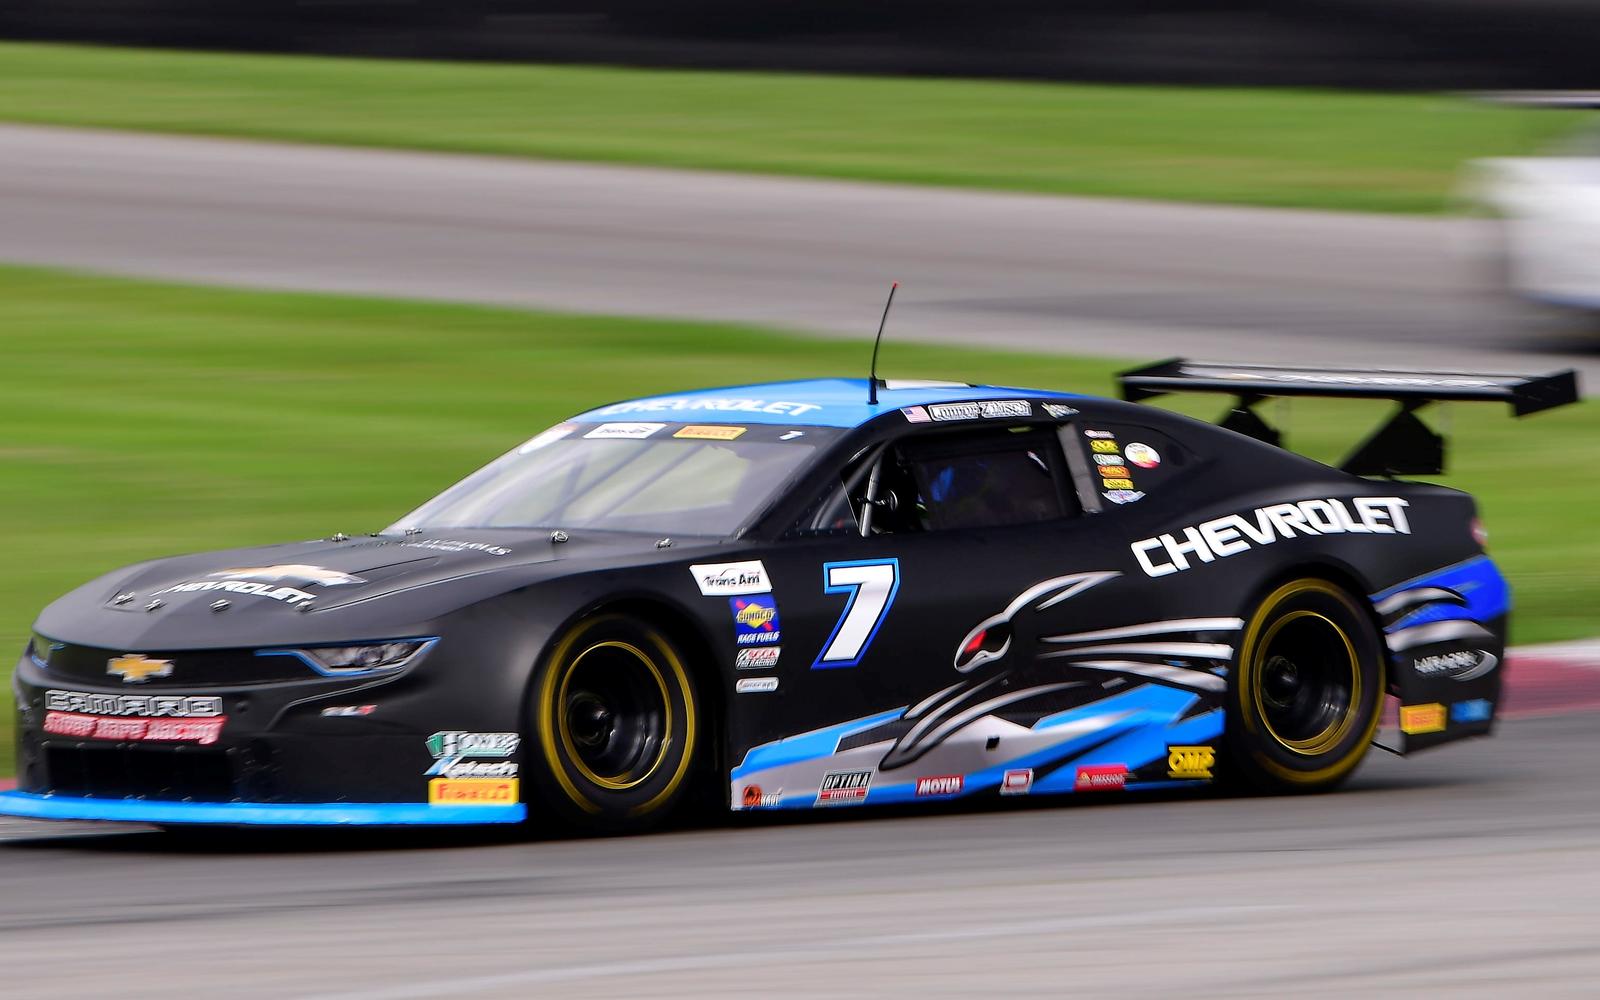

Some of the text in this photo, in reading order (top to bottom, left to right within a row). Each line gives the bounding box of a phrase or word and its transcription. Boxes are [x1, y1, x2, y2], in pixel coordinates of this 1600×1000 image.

[601, 398, 822, 417] CHEVROLET
[1131, 497, 1411, 577] CHEVROLET
[739, 573, 760, 585] Am
[737, 608, 774, 622] SUNOCO
[817, 560, 899, 667] 7
[737, 631, 780, 644] RACE FUELS
[45, 689, 223, 717] CAMARO
[824, 772, 871, 789] OPTIMA
[917, 776, 961, 794] MOTUL
